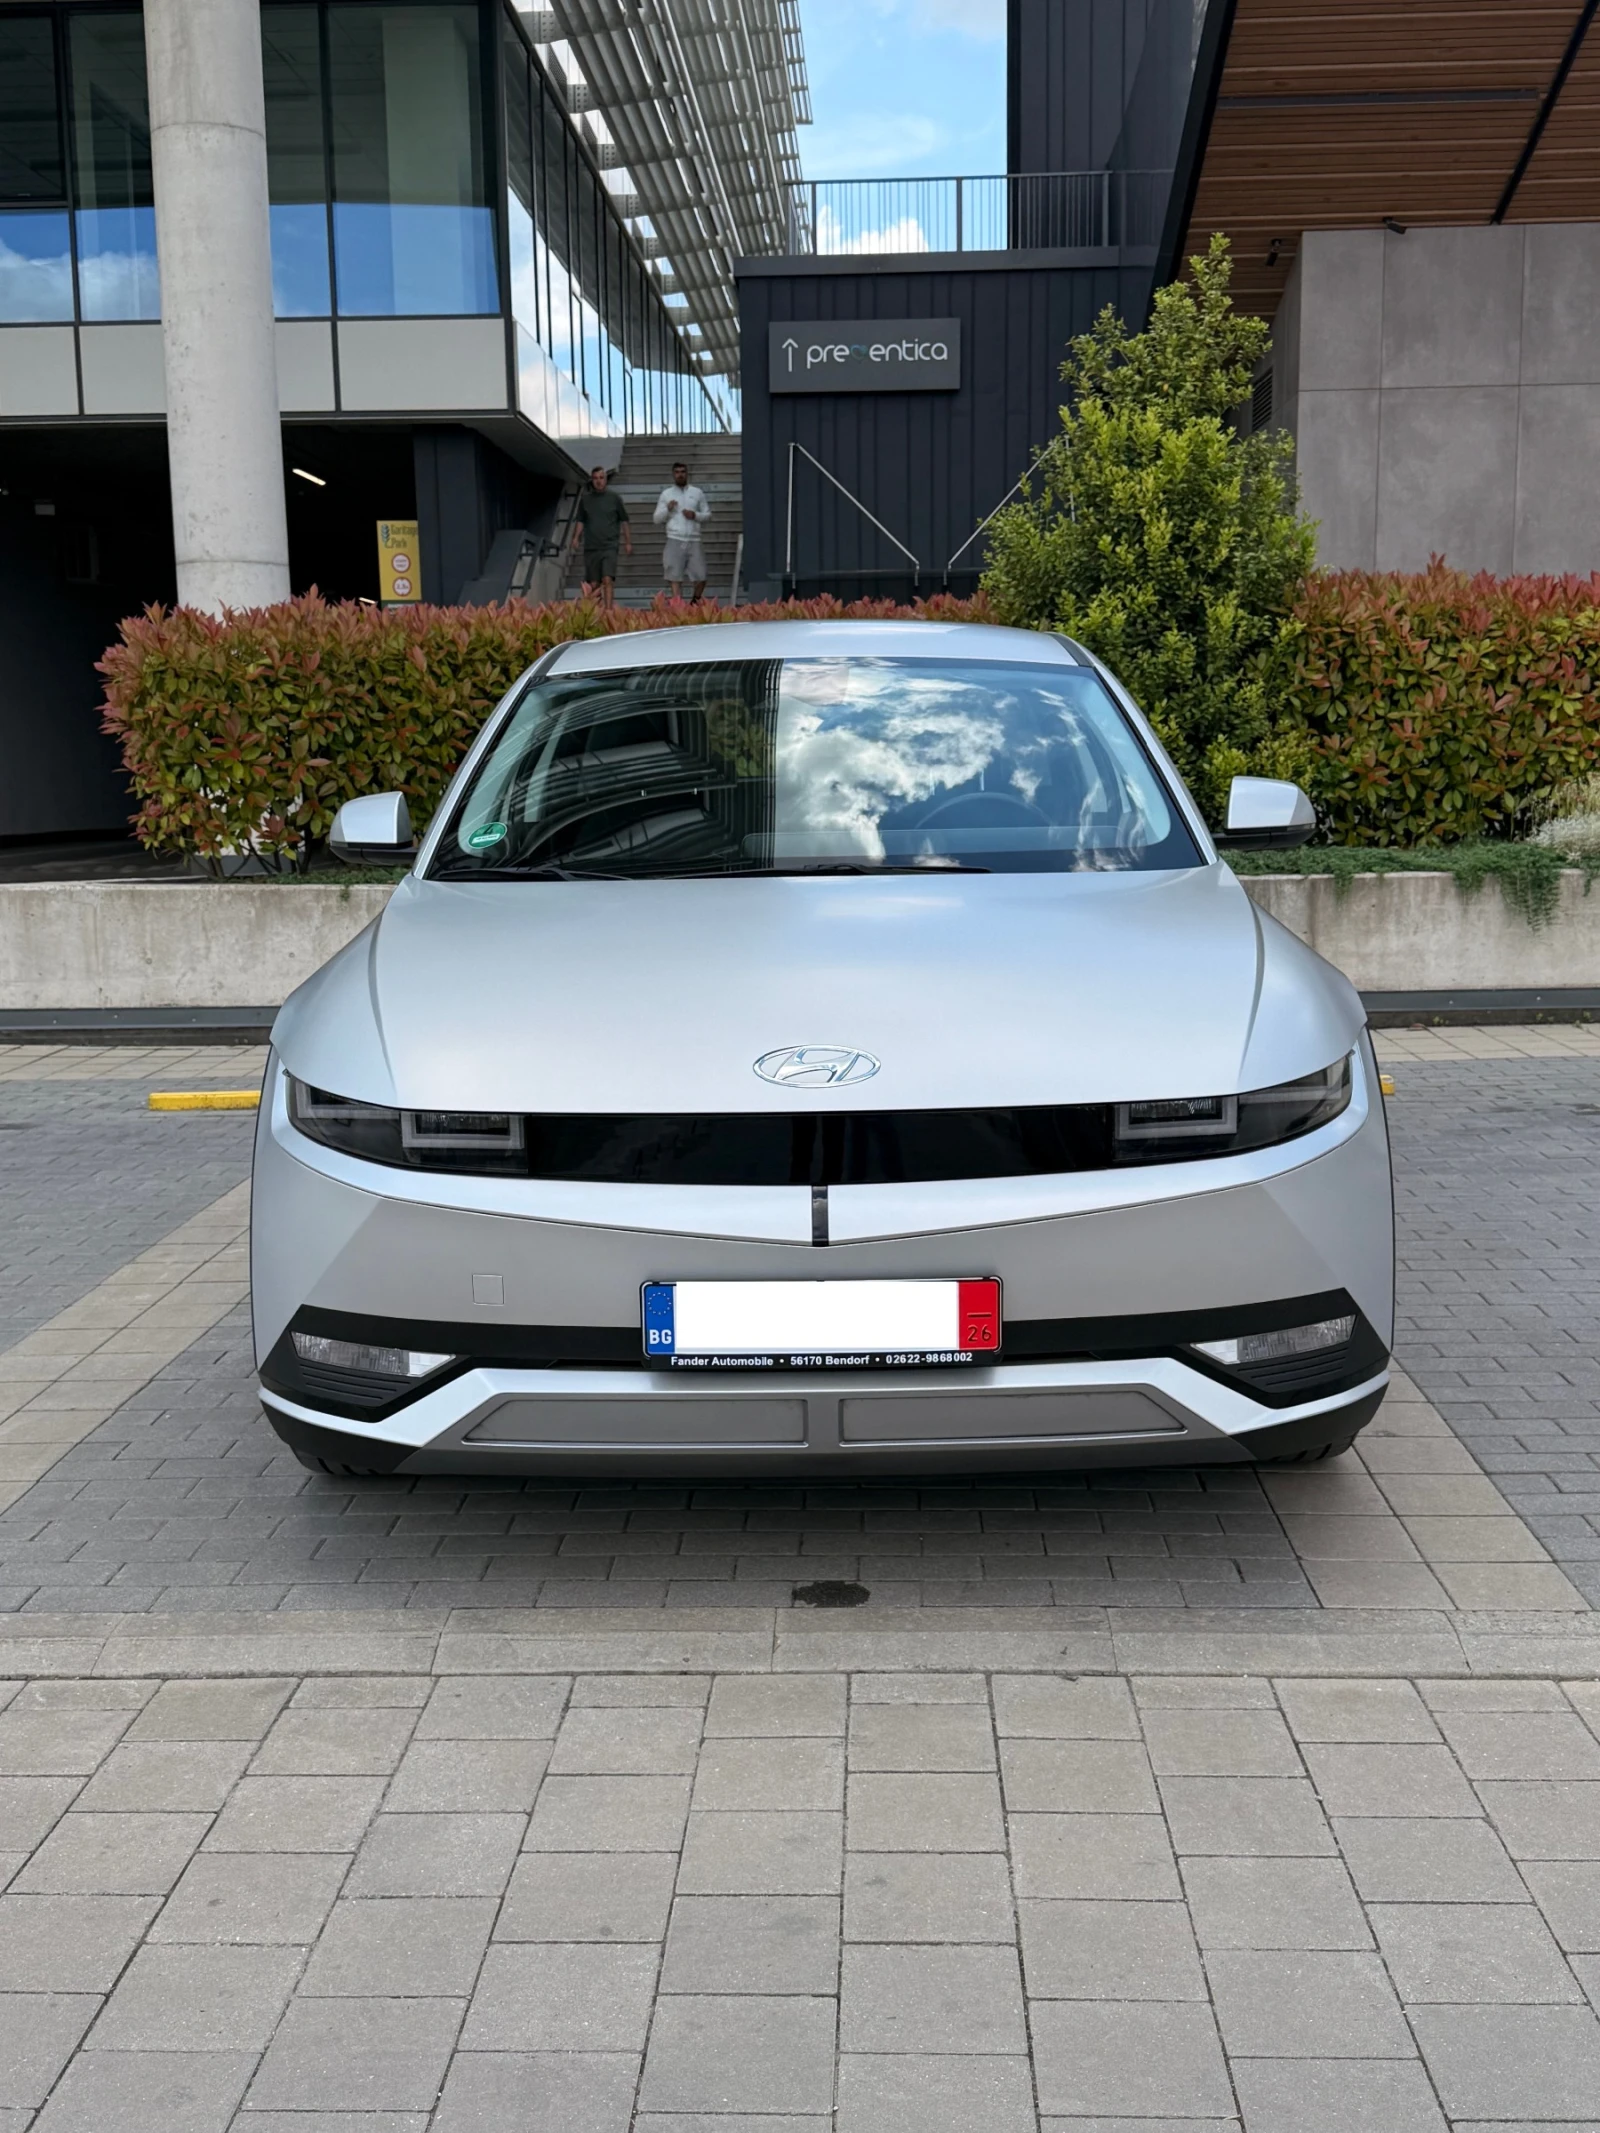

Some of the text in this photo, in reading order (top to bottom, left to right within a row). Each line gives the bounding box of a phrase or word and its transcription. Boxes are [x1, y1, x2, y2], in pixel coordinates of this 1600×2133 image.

[649, 1329, 672, 1345] BG
[967, 1324, 992, 1342] 26
[671, 1352, 973, 1366] Fander Automobile 56170 Bendorf 02622-9868002
